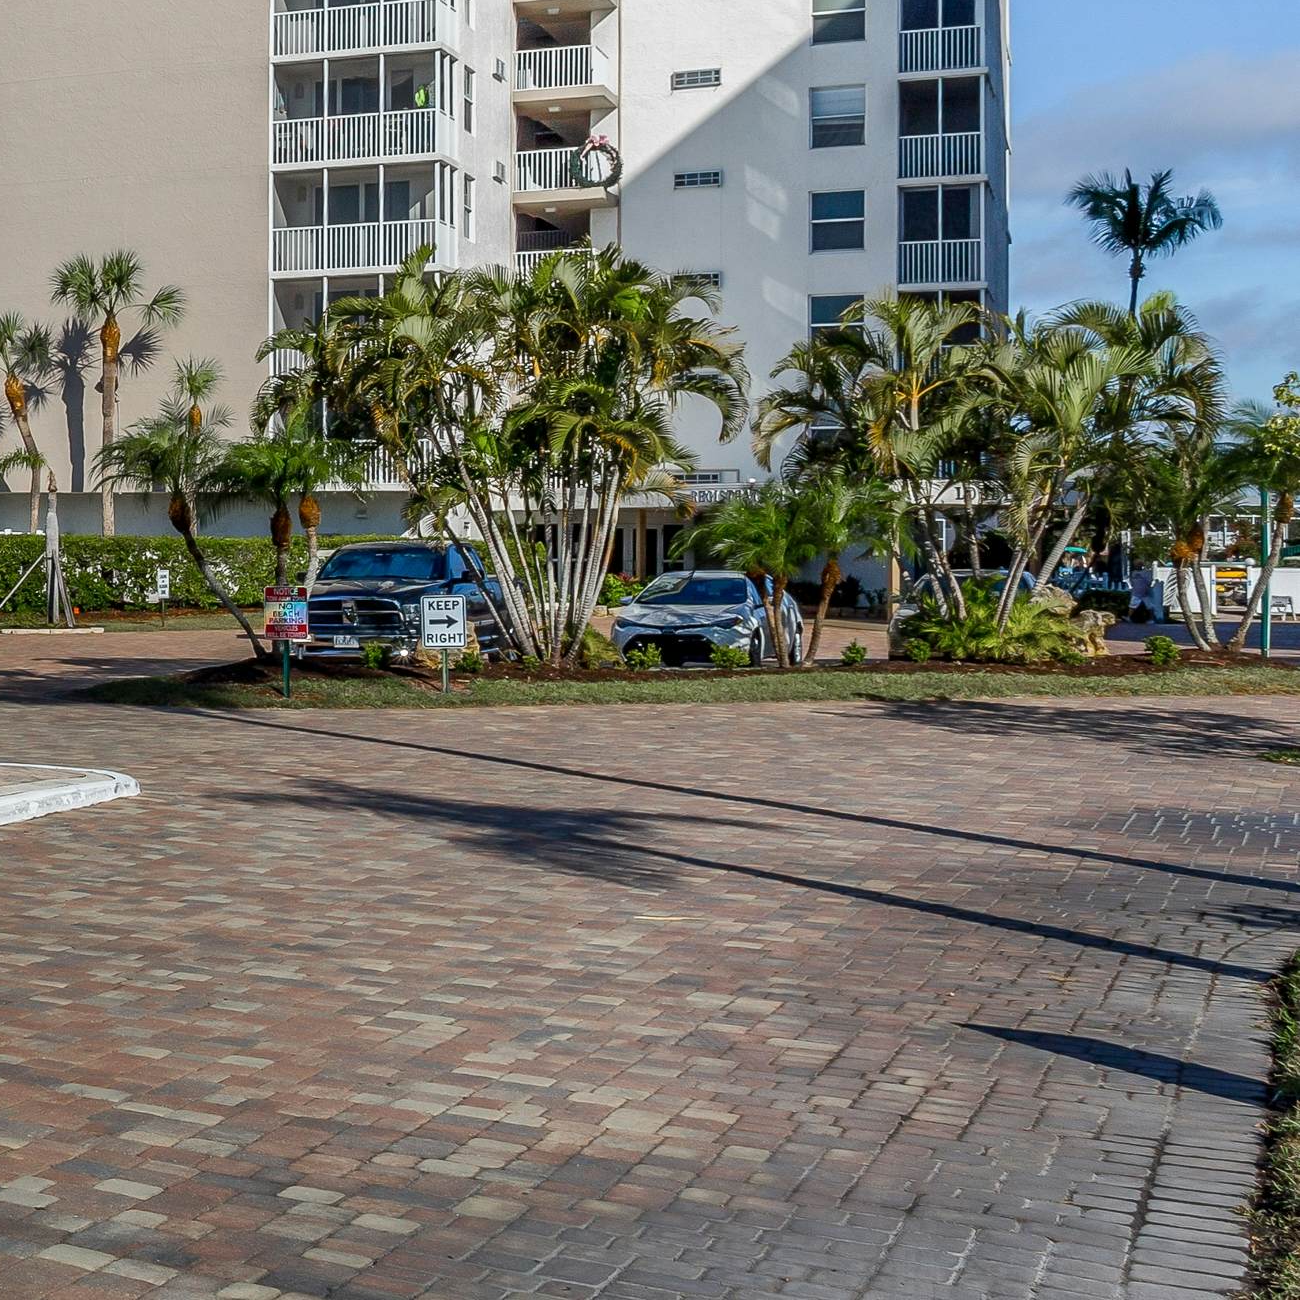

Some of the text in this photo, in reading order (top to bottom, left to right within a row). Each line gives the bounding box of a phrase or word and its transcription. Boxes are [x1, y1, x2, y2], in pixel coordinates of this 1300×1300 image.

[273, 587, 299, 596] NOTICE
[278, 602, 294, 610] NO
[427, 600, 460, 611] KEEP
[426, 632, 464, 644] RIGHT
